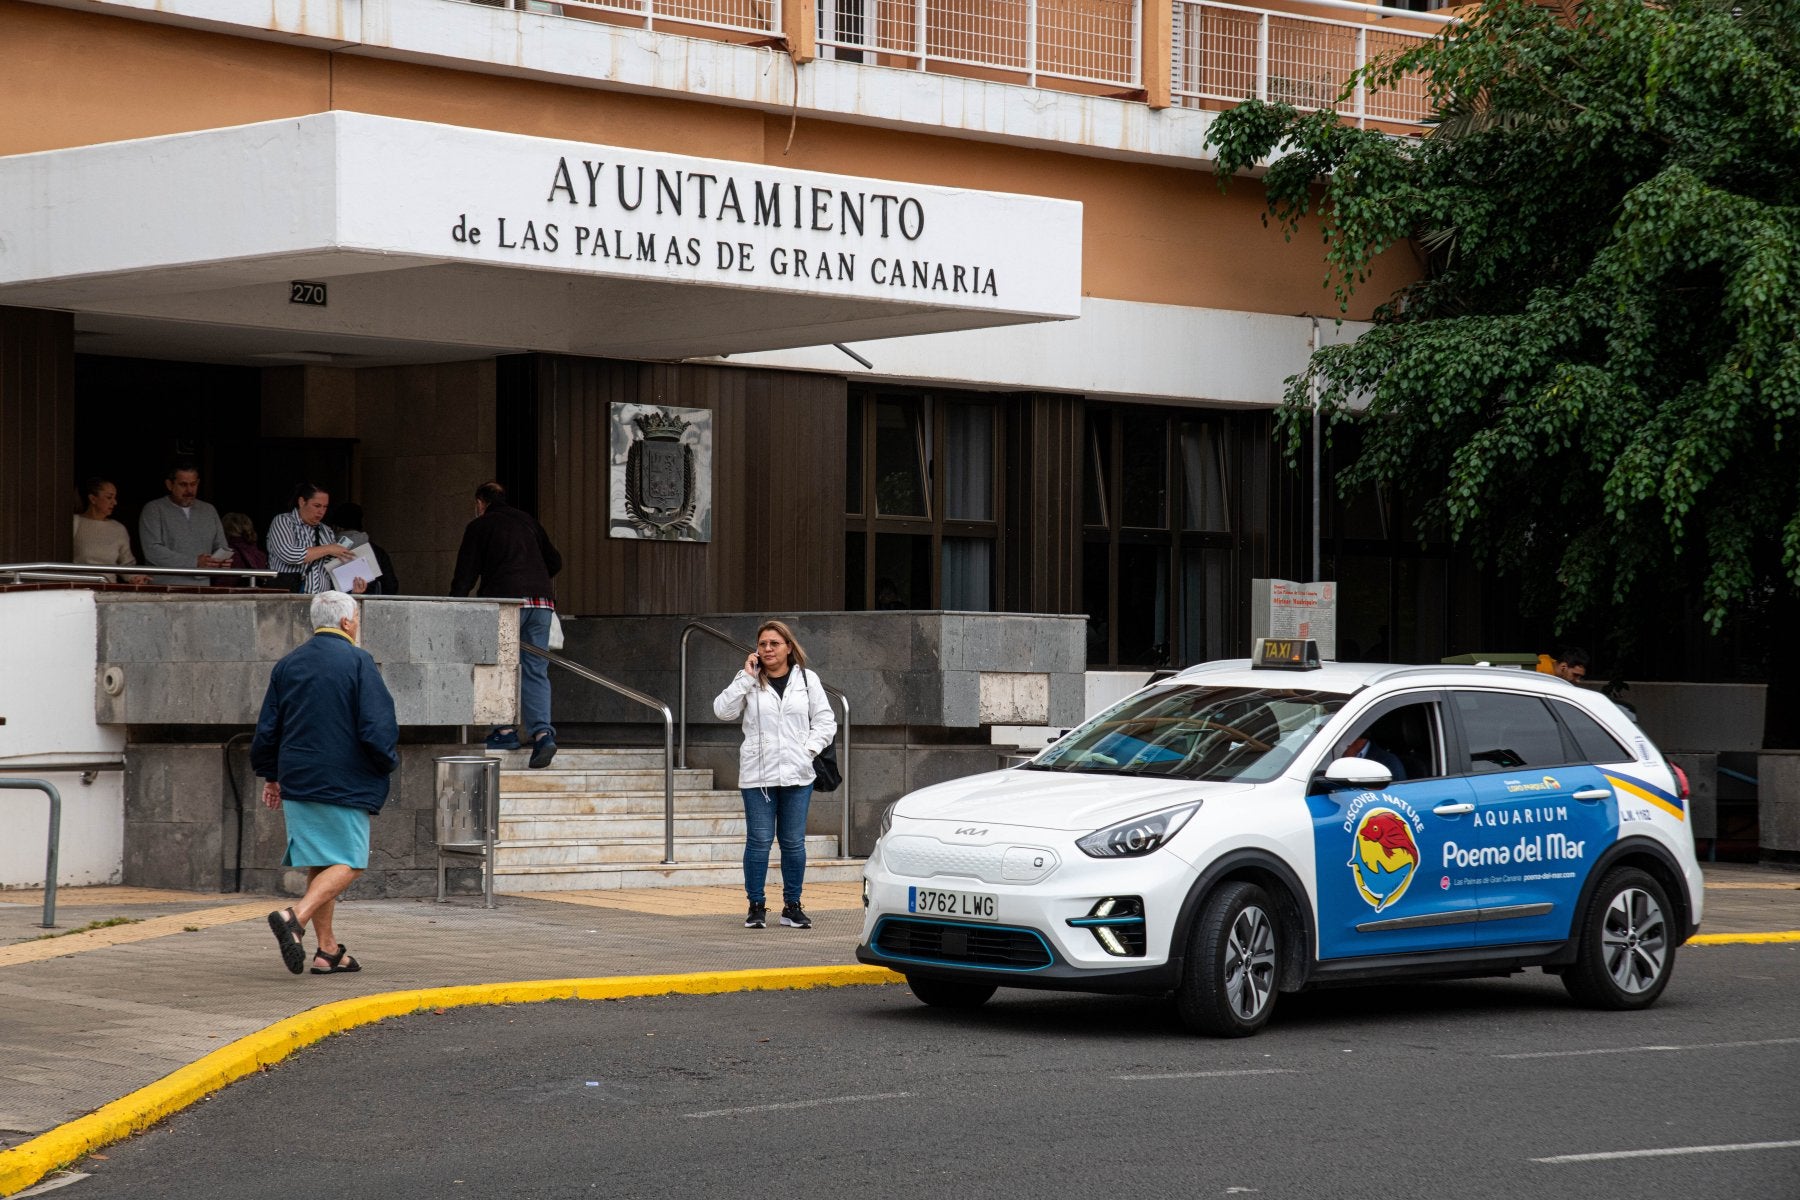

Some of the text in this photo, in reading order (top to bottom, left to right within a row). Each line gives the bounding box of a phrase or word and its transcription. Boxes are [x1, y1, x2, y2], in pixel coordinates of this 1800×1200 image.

[548, 157, 925, 241] AYUNTAMIENTO
[452, 214, 999, 296] de LAS PALMAS DE GRAN CANARIA
[293, 284, 324, 303] 270
[1265, 642, 1292, 659] TAXI
[1343, 792, 1425, 833] DISCOVER NATURE
[1473, 806, 1568, 827] AQUARIUM
[1442, 833, 1586, 868] Poema del Mar
[1453, 878, 1463, 886] Las
[1464, 877, 1482, 885] Palmas
[1490, 875, 1502, 883] Gran
[1523, 872, 1576, 882] poema-del-mar.com
[919, 891, 994, 916] 3762 LWG
